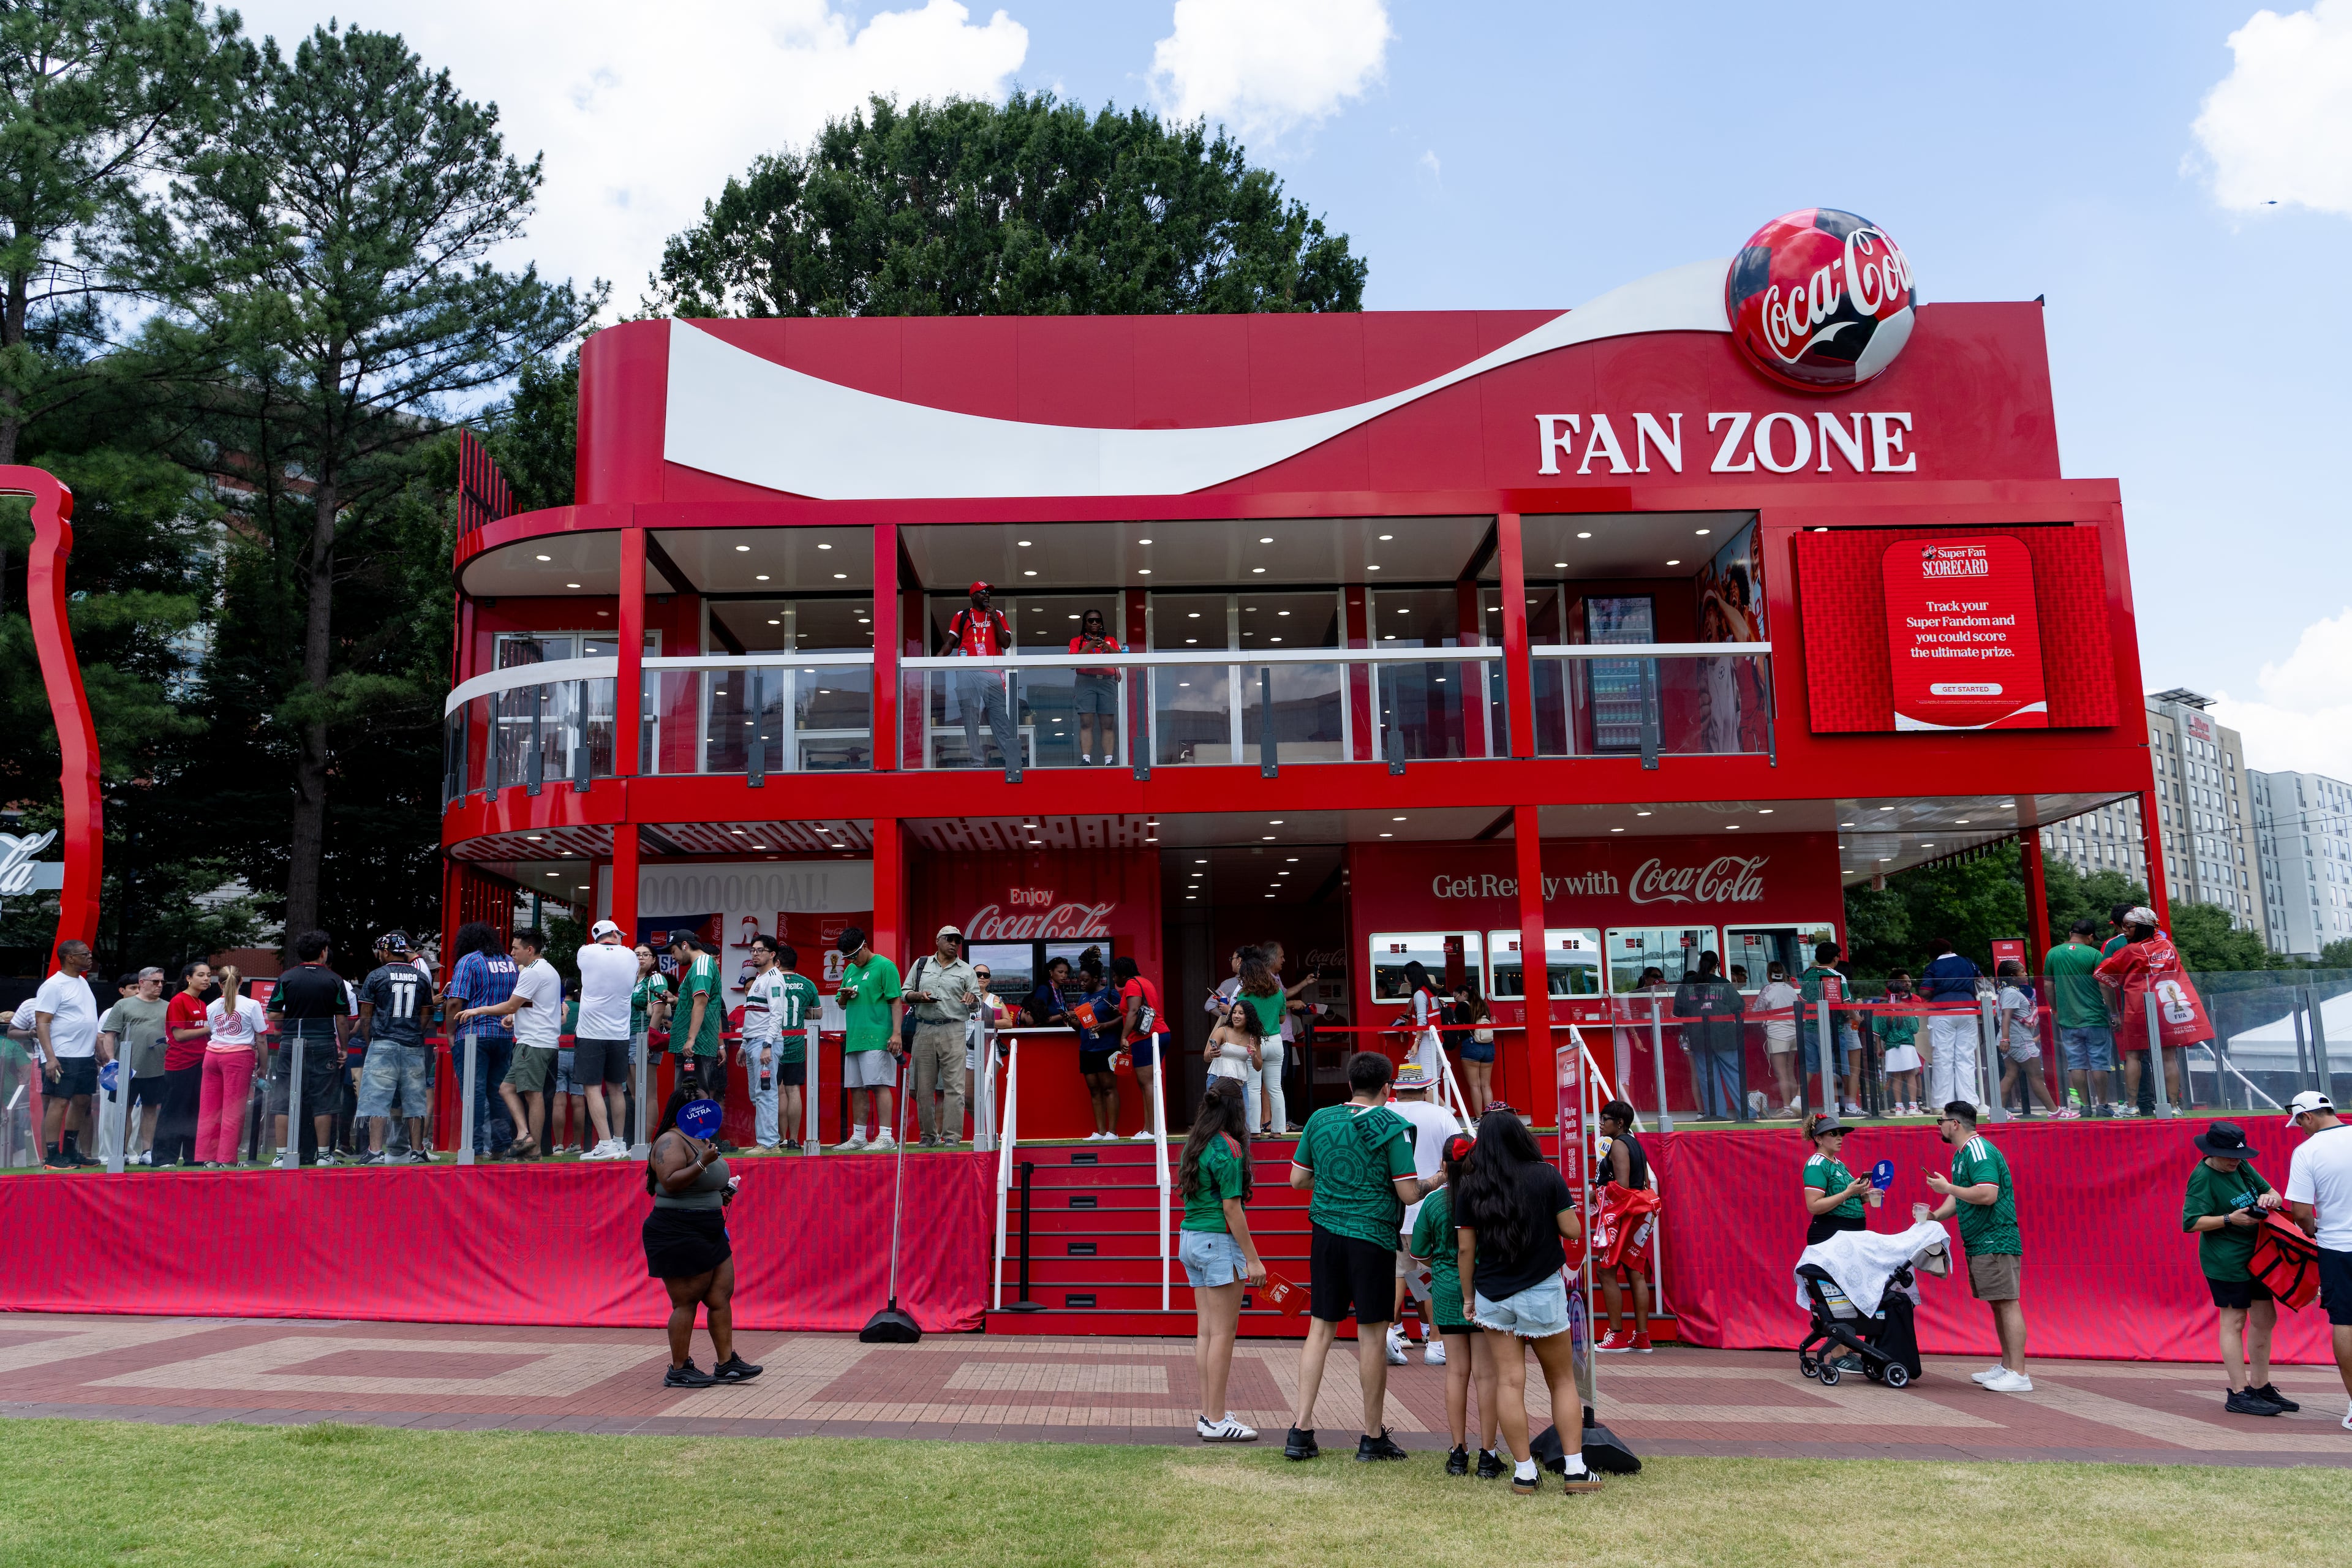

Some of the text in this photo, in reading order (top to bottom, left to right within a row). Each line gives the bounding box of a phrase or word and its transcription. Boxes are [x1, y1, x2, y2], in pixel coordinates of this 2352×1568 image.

[1762, 227, 1913, 364] Coca-Cola
[1535, 412, 1917, 475] FAN ZONE
[1938, 548, 1986, 560] Super Fan
[1922, 559, 1988, 576] SCORECARD
[1926, 601, 1989, 613] Track your
[1906, 614, 2015, 629] Super Fandom and
[1916, 631, 2006, 644] you could score
[1910, 646, 2015, 659] the ultimate prize.
[1432, 875, 1477, 898] Get
[1564, 871, 1619, 895] with
[1629, 856, 1770, 904] Coca-Cola
[1009, 887, 1054, 906] Enjoy
[964, 903, 1117, 940] Coca-Cola
[1305, 949, 1346, 967] Coca-Co
[488, 961, 516, 973] USA
[390, 972, 418, 982] BLANCO
[391, 982, 417, 1018] 11
[783, 995, 799, 1027] 11
[687, 1107, 712, 1120] ULTRA
